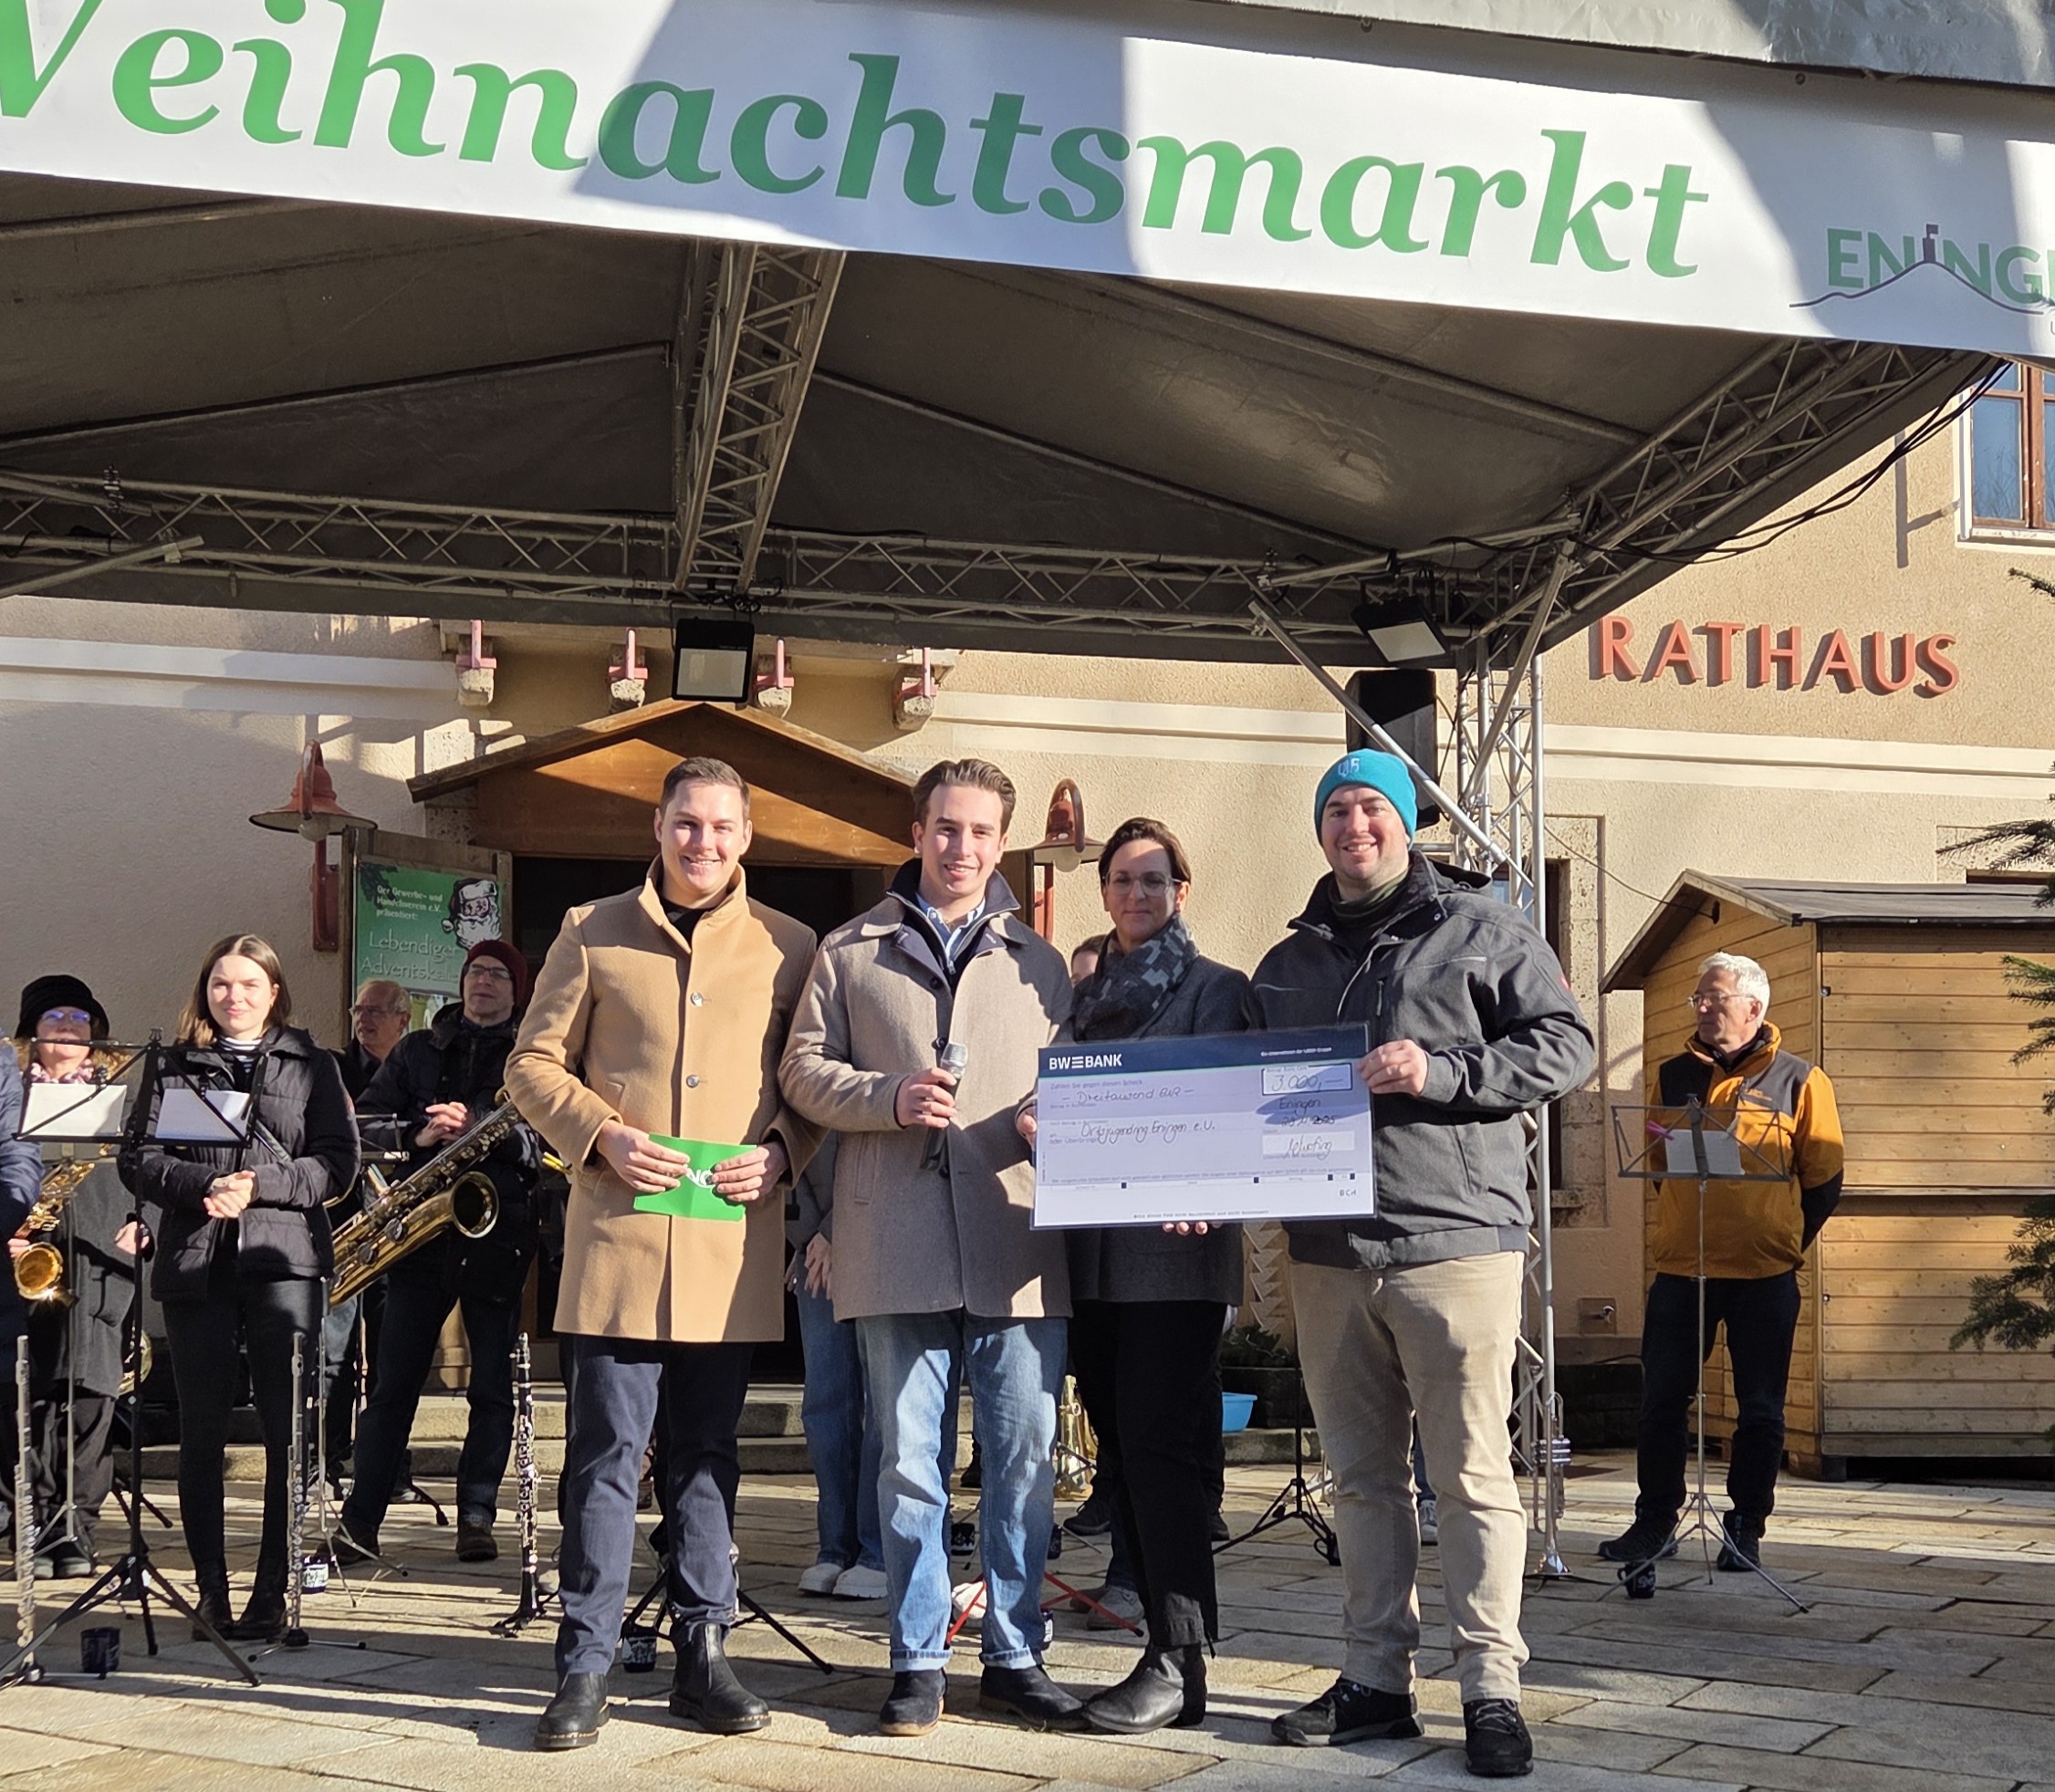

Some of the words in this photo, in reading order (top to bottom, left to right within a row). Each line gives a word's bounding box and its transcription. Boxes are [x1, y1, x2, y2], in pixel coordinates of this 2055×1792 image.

[1827, 224, 2055, 305] ENING
[1599, 615, 1960, 695] RATHAUS
[428, 903, 442, 912] e.V.
[429, 894, 443, 902] und
[370, 928, 459, 964] Lebendiger
